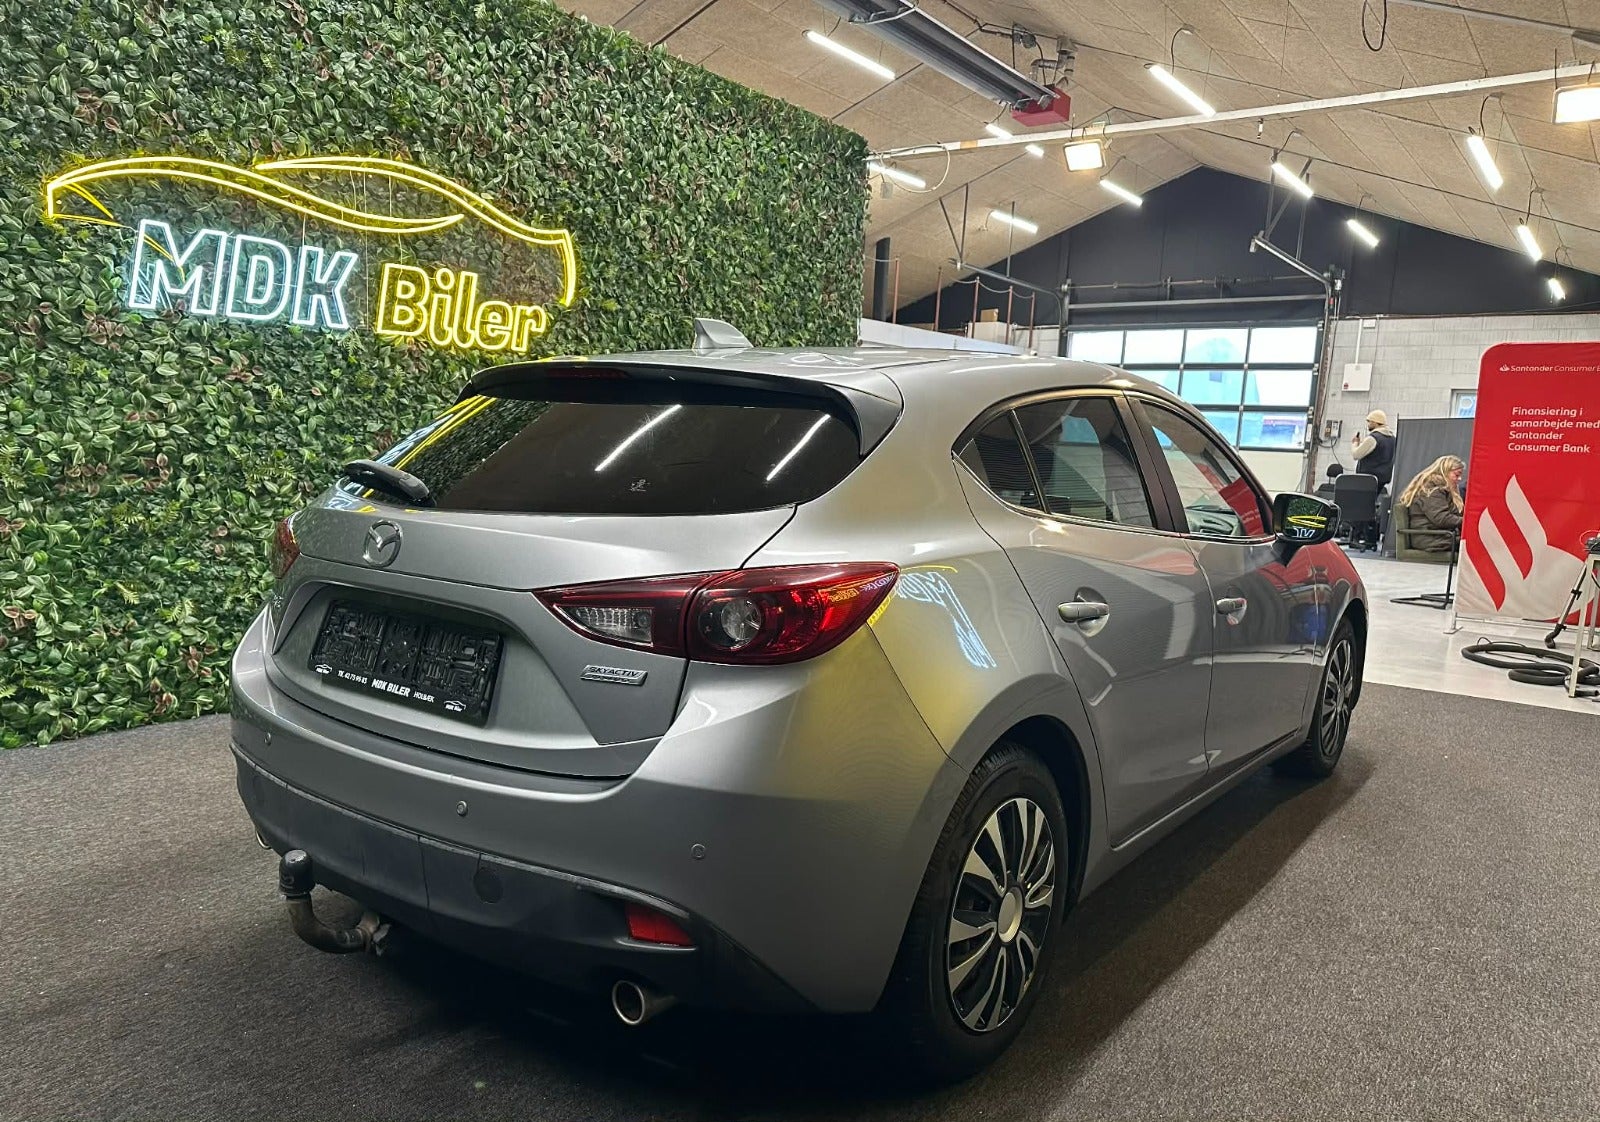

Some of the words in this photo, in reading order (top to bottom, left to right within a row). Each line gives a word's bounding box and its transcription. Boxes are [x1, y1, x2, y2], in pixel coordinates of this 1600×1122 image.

[128, 218, 358, 330] MDK
[375, 262, 547, 353] Biler
[1512, 406, 1578, 417] Finansiering
[1579, 407, 1583, 416] i
[1510, 419, 1574, 430] samarbejde
[1576, 420, 1600, 429] med
[1509, 430, 1565, 440] Santander
[1507, 442, 1561, 452] Consumer
[1562, 444, 1591, 453] Bank
[588, 666, 639, 677] SKYACTIV
[386, 682, 411, 697] BILER
